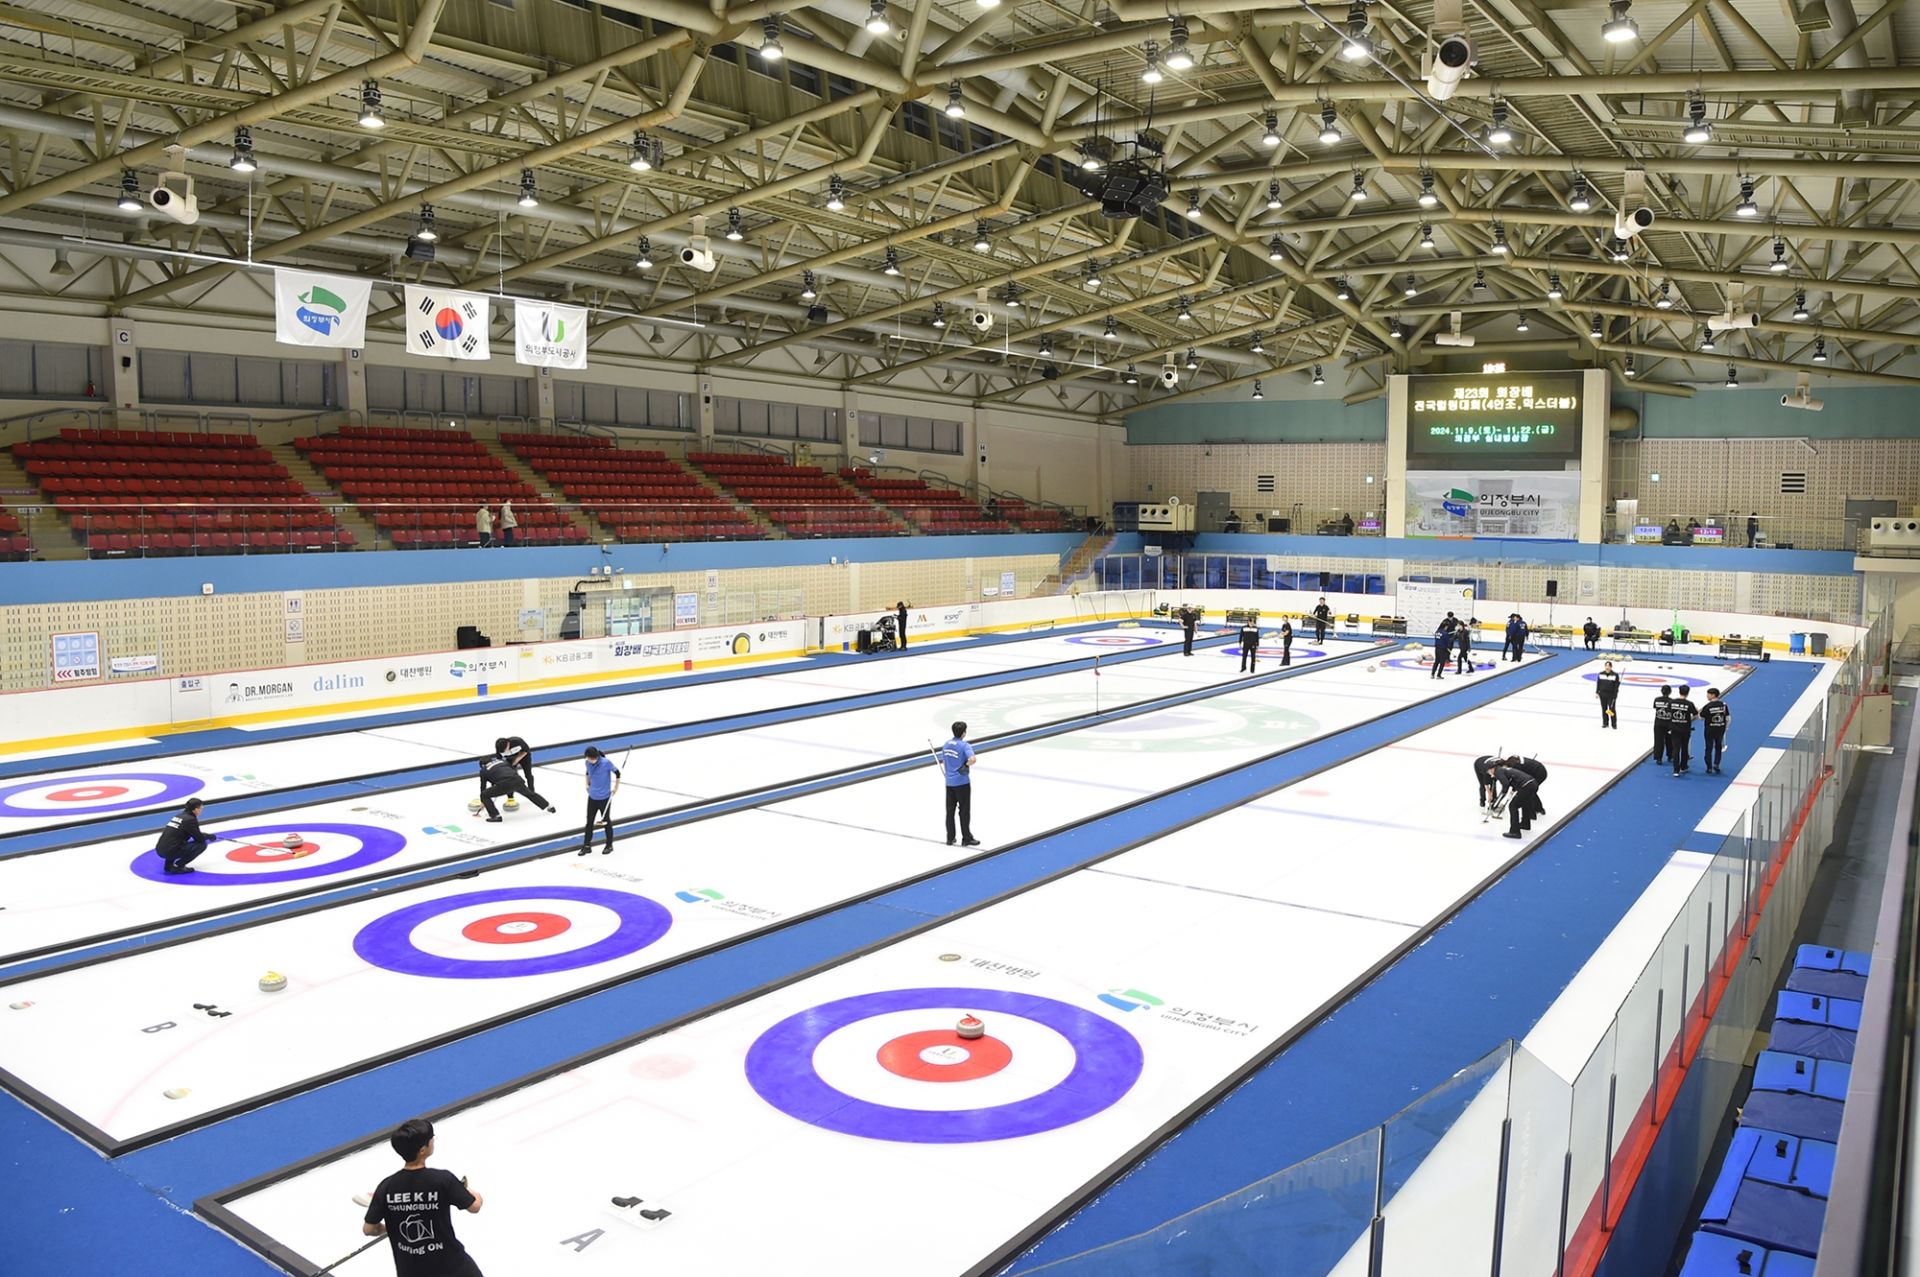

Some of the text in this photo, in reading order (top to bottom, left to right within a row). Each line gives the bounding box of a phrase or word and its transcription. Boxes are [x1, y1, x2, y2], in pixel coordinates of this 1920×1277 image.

[119, 332, 129, 342] C
[351, 349, 359, 359] D
[525, 344, 577, 359] 의정부도시공사
[541, 367, 548, 376] E
[703, 383, 709, 391] F
[1453, 386, 1533, 399] 제23회 회장배
[1480, 493, 1541, 507] 의정부시
[555, 651, 593, 663] KB금융그룹
[614, 644, 642, 657] 회장배
[468, 660, 507, 672] 의정부시
[181, 679, 201, 689] 출입구
[313, 674, 364, 692] dalim
[1167, 1007, 1259, 1032] 의정부시
[140, 1021, 177, 1034] B
[386, 1191, 438, 1204] LEE K H
[427, 1241, 444, 1252] ON
[559, 1228, 606, 1253] A
